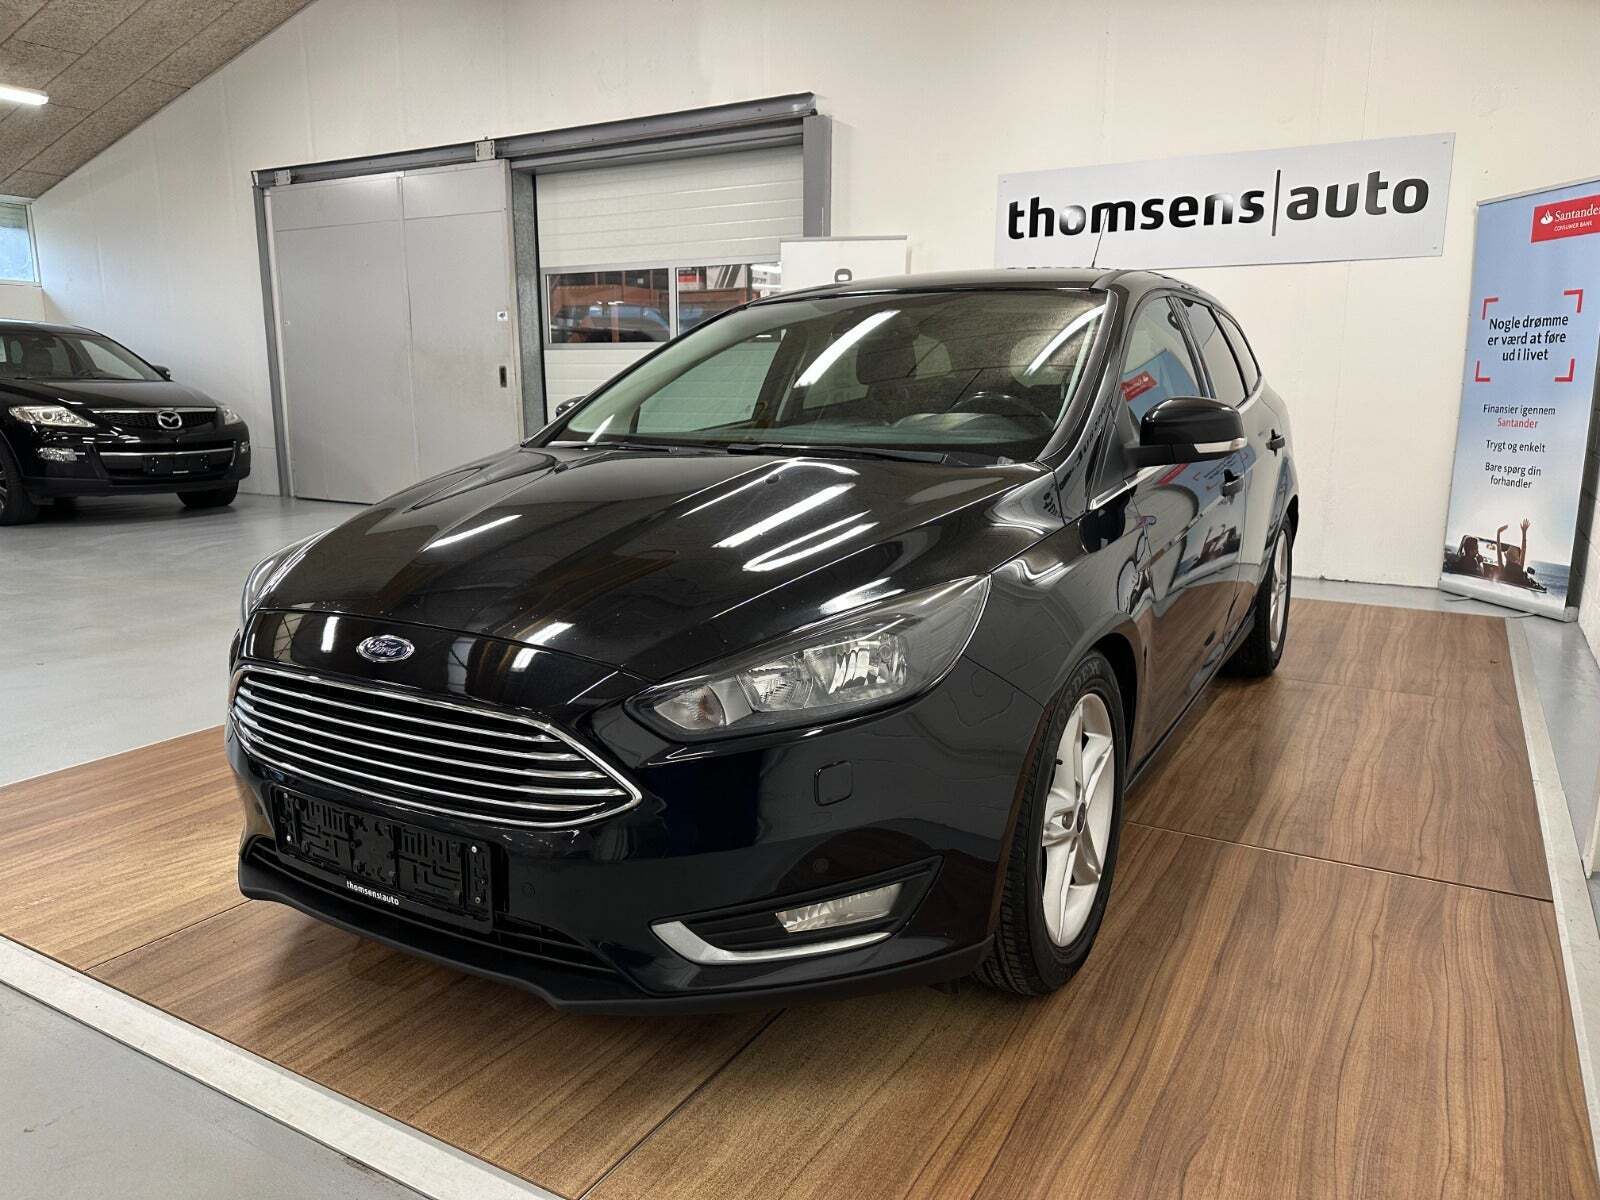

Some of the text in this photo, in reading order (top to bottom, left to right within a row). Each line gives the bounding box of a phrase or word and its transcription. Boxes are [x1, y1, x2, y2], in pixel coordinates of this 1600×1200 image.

[1553, 220, 1593, 232] CONSUMER BANK
[1489, 315, 1569, 333] Nogle drømme
[1487, 330, 1567, 346] er værd at føre
[1502, 348, 1549, 361] ud i livet
[1483, 403, 1556, 417] Finansier igennem
[1497, 417, 1539, 429] Santander
[1486, 439, 1545, 453] Trygt og enkelt
[1485, 462, 1542, 477] Bare spørg din
[1490, 474, 1533, 488] forhandler
